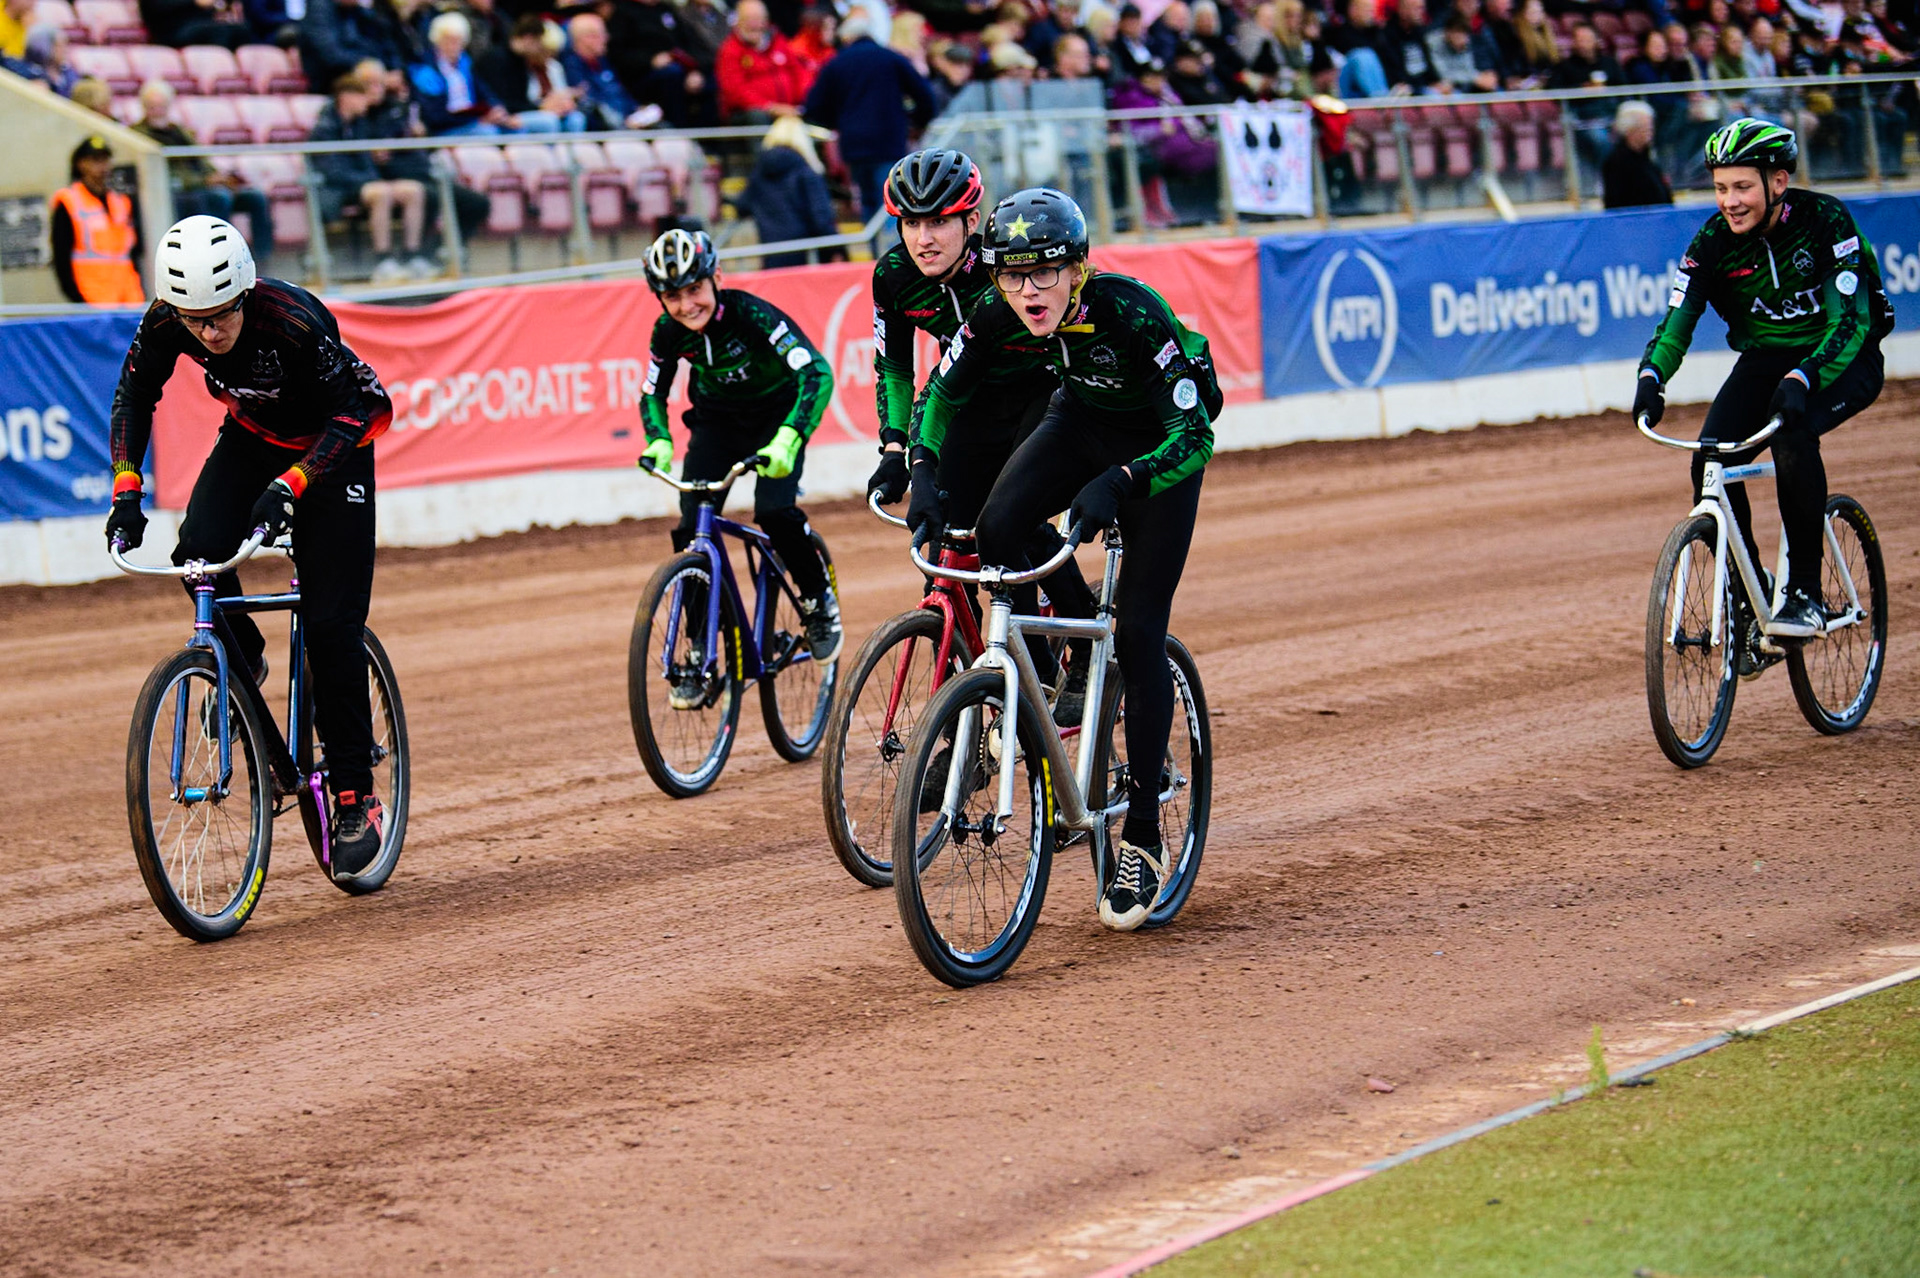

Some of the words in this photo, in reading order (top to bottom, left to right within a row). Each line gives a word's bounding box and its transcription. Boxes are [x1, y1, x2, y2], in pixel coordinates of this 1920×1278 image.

[1430, 270, 1598, 338] Delivering
[1602, 258, 1678, 320] Worl
[1884, 242, 1920, 295] So
[1750, 284, 1822, 320] A&T
[1328, 295, 1382, 342] ATPI
[840, 337, 876, 388] AT
[387, 361, 594, 432] CORPORATE
